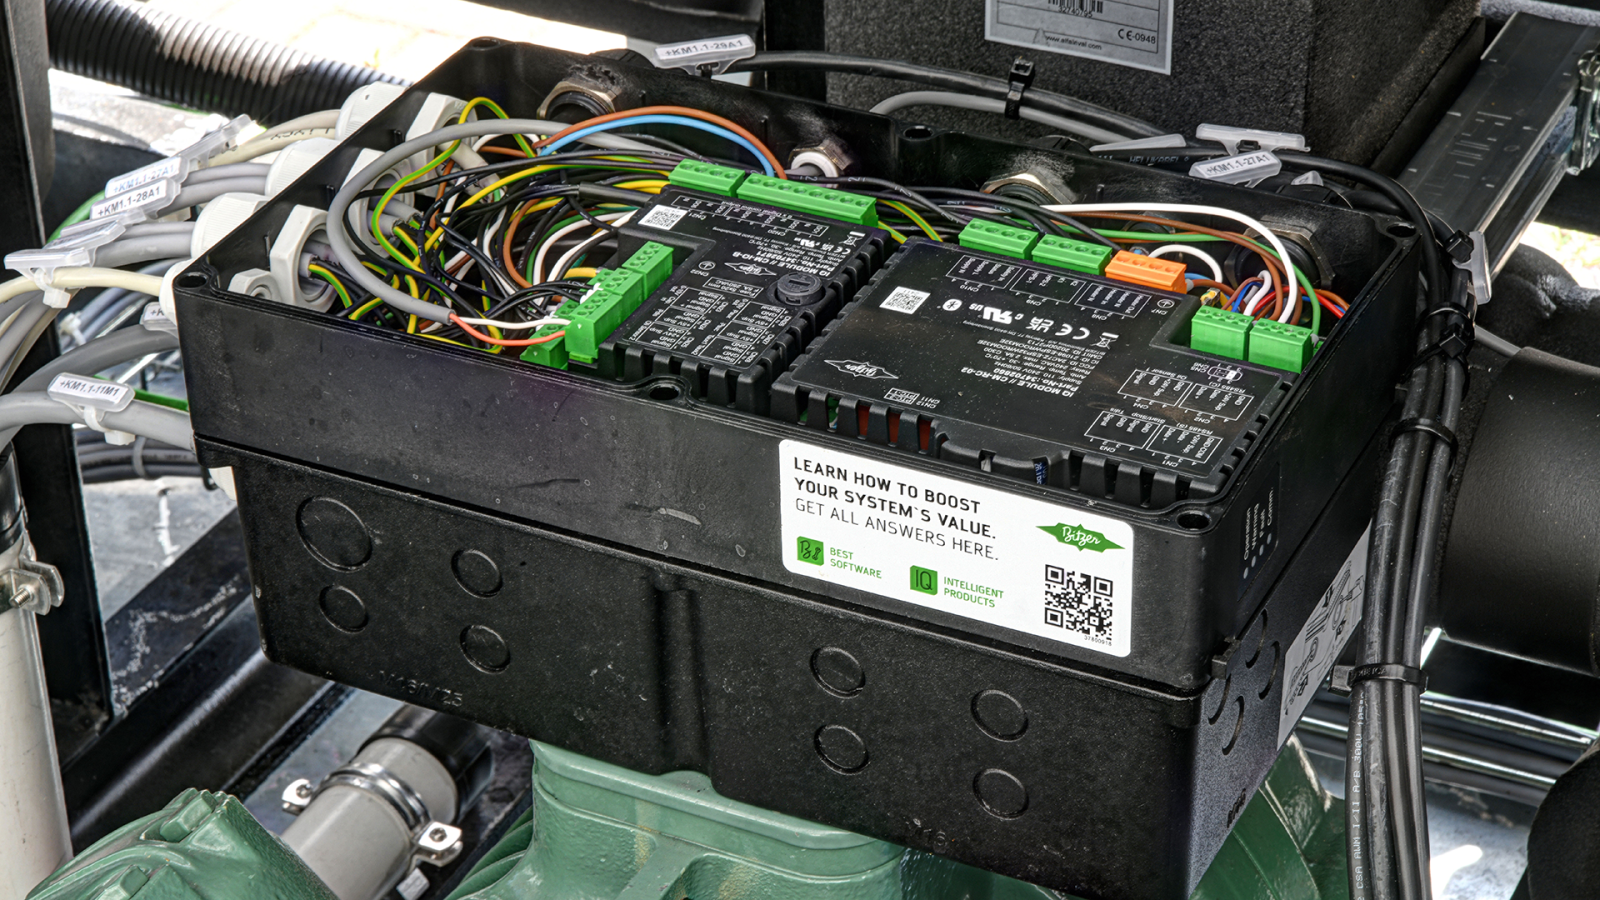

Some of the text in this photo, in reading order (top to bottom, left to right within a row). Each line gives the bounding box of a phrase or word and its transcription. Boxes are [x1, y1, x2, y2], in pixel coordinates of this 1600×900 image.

[664, 39, 744, 57] +KM1.1-29A1
[1206, 154, 1271, 175] +KM1.1-27A1
[97, 185, 161, 217] +KM1.1-28A1
[732, 251, 769, 263] CM-IO-B
[690, 269, 709, 277] CN22
[777, 262, 818, 274] MODULE
[960, 284, 979, 292] CN10
[1091, 312, 1107, 320] CN8
[961, 367, 1008, 382] CM-RC-02
[1151, 369, 1176, 378] Sensor
[59, 378, 121, 398] +KM1.1-11M1
[1017, 378, 1061, 394] MODULE
[1221, 385, 1246, 394] RS485
[1131, 412, 1166, 424] Start/Stop
[1188, 426, 1213, 435] RS485
[1099, 445, 1116, 453] CN3
[794, 456, 981, 514] LEARN HOW TO BOOST
[794, 477, 838, 500] YOUR
[937, 512, 997, 539] VALUE.
[795, 497, 999, 561] GET ALL ANSWERS HERE.
[1062, 526, 1101, 547] Bitzer
[1252, 502, 1260, 551] Warning
[829, 547, 854, 561] BEST
[830, 558, 882, 580] SOFTWARE
[915, 569, 933, 590] IQ
[944, 576, 1005, 600] INTELLIGENT
[944, 587, 996, 609] PRODUCTS
[1354, 733, 1363, 763] 300V
[1352, 770, 1361, 793] A/B
[1352, 801, 1361, 829] I/II
[1354, 834, 1362, 860] AWM
[1356, 865, 1364, 890] CSA
